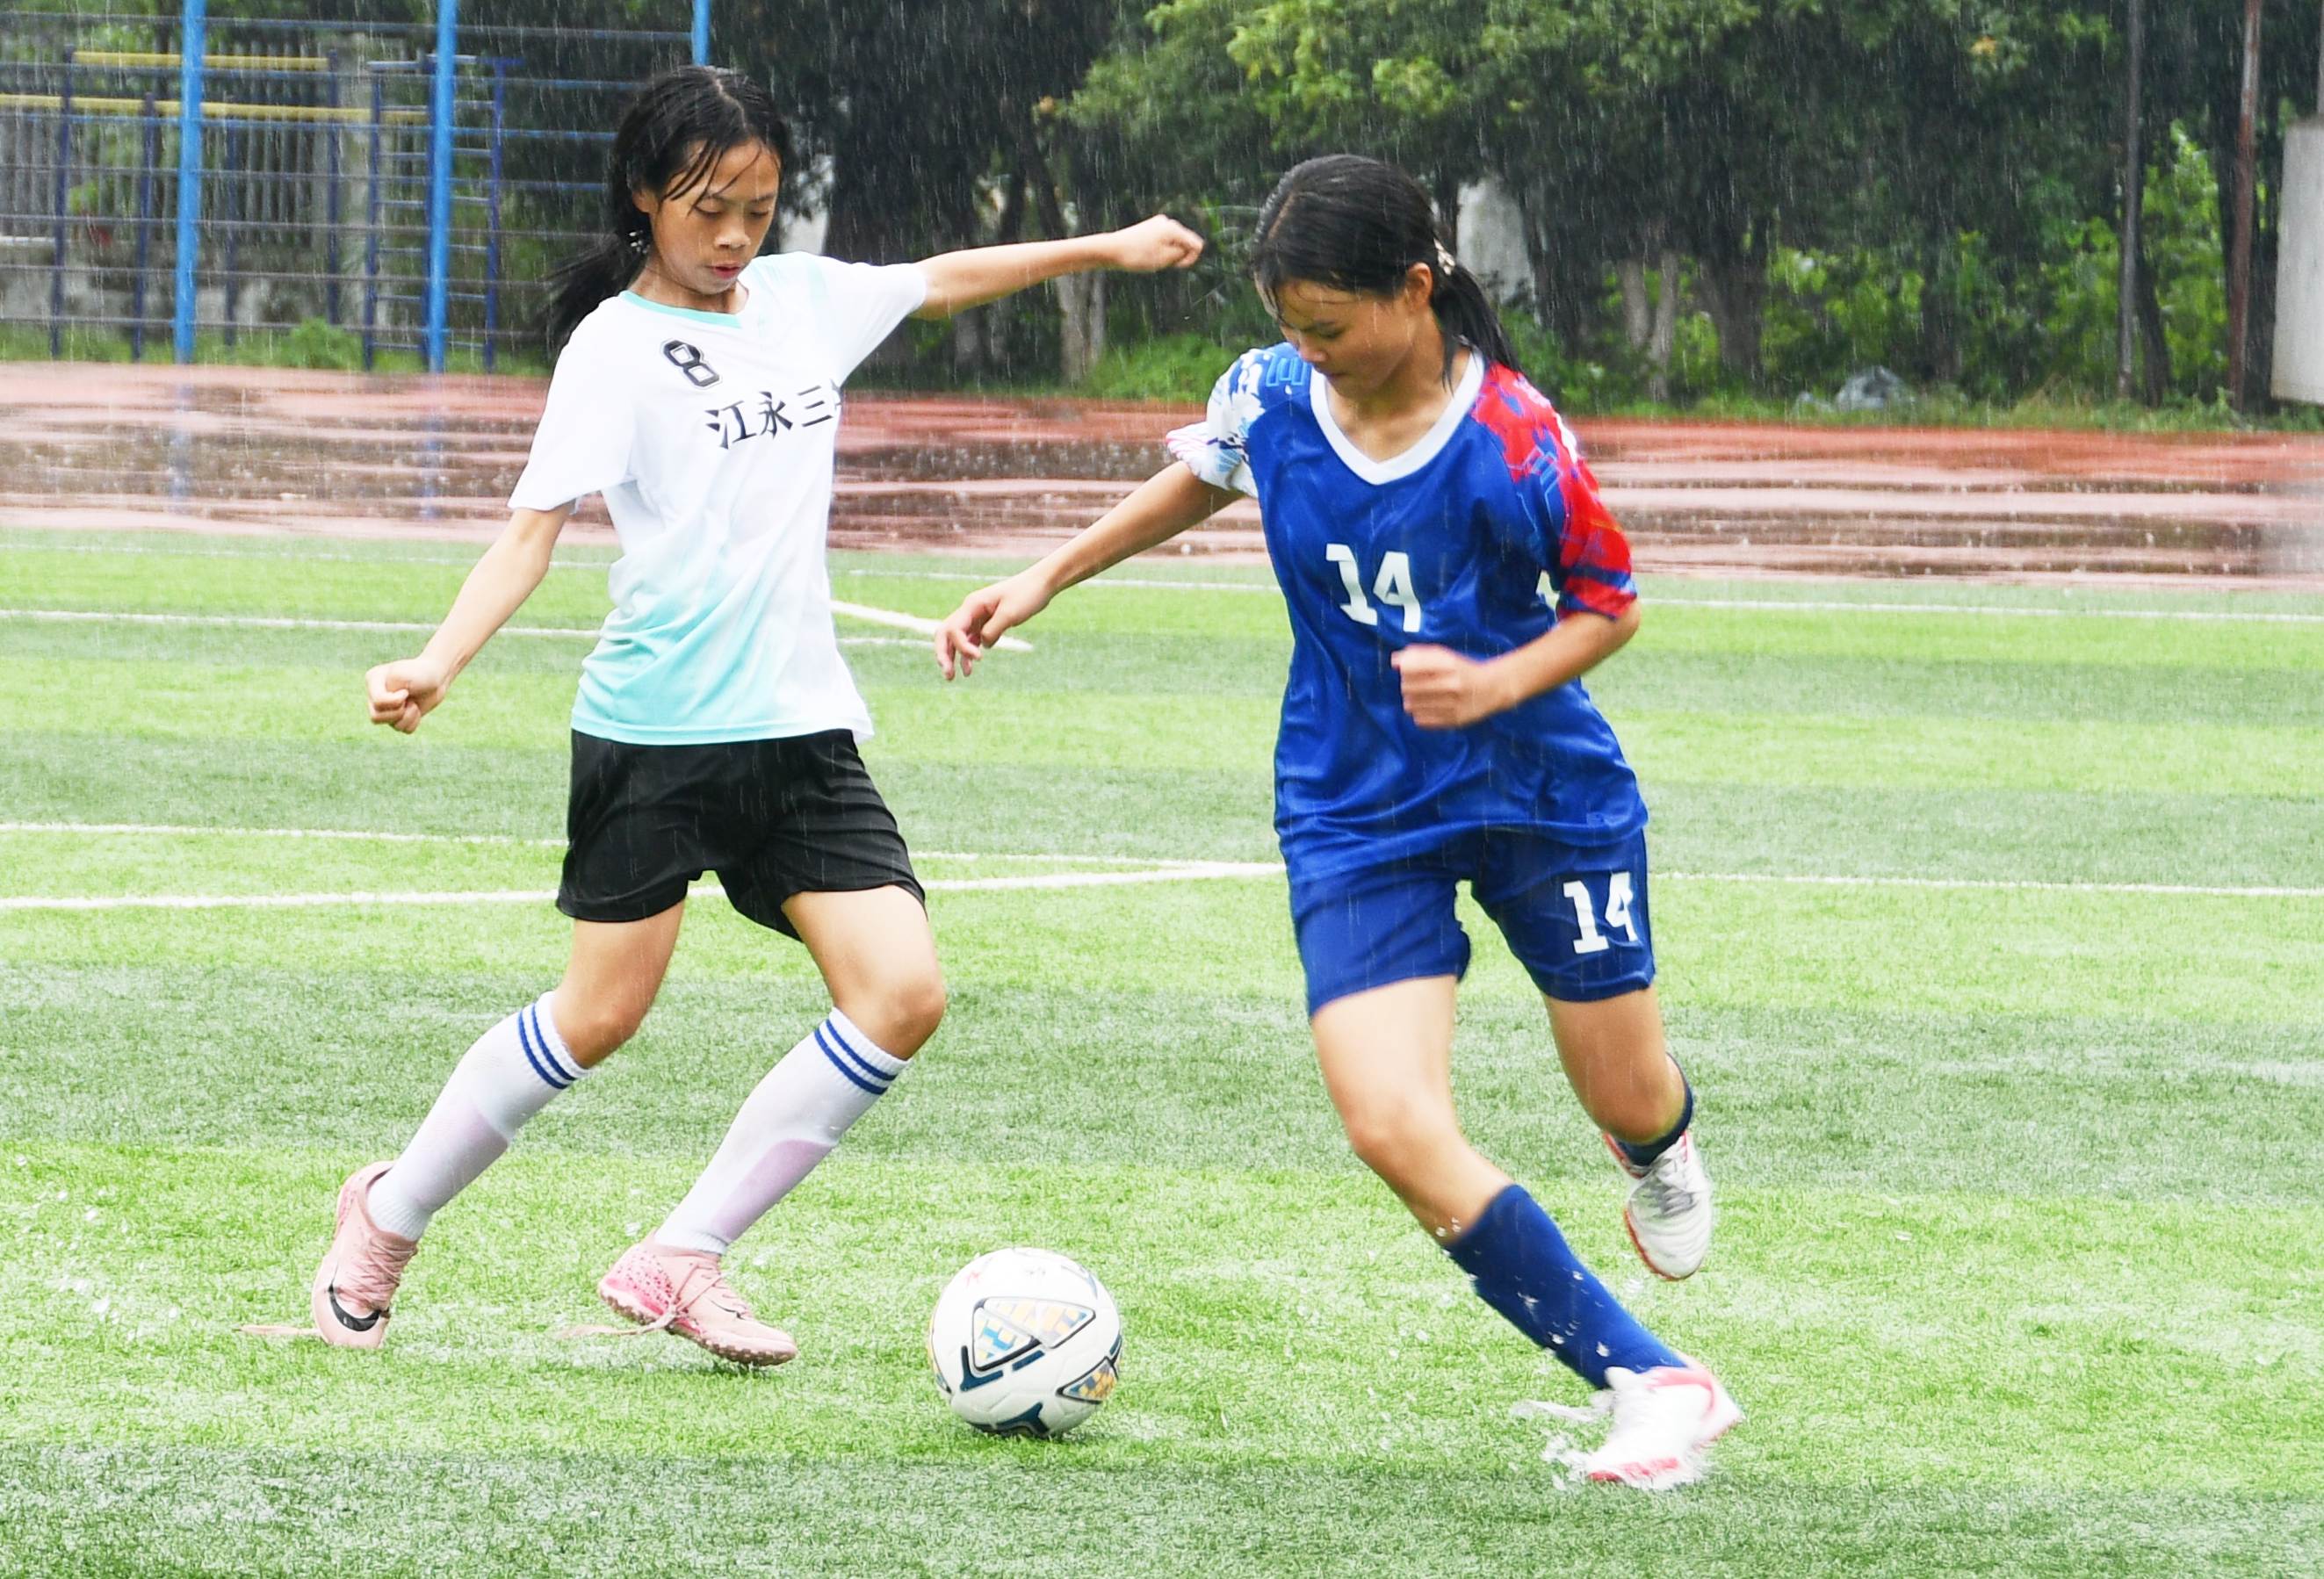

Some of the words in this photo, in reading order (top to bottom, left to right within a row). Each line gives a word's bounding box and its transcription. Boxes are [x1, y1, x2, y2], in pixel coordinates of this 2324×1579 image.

[660, 338, 722, 389] 8
[1325, 543, 1421, 632] 14
[1563, 870, 1639, 955] 14
